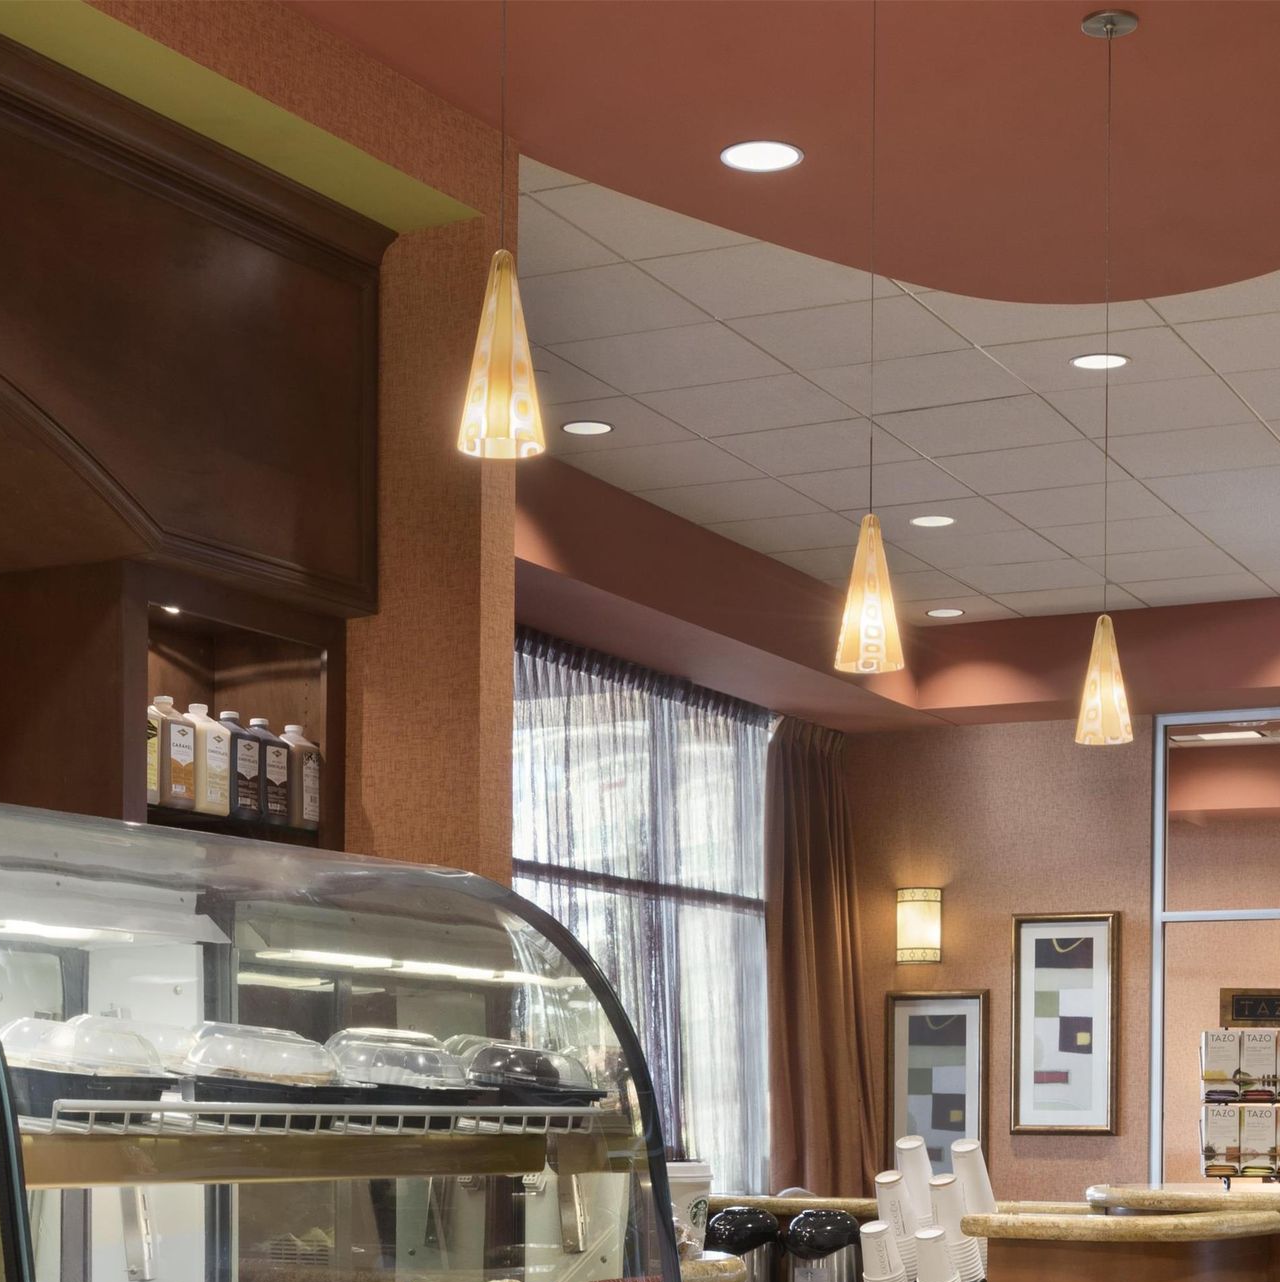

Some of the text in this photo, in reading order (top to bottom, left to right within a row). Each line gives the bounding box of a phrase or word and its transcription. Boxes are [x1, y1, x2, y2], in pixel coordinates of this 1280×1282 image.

[1211, 1034, 1236, 1043] TAZO
[1247, 1034, 1272, 1043] TAZO
[1211, 1109, 1236, 1118] TAZO
[1247, 1110, 1272, 1119] TAZO
